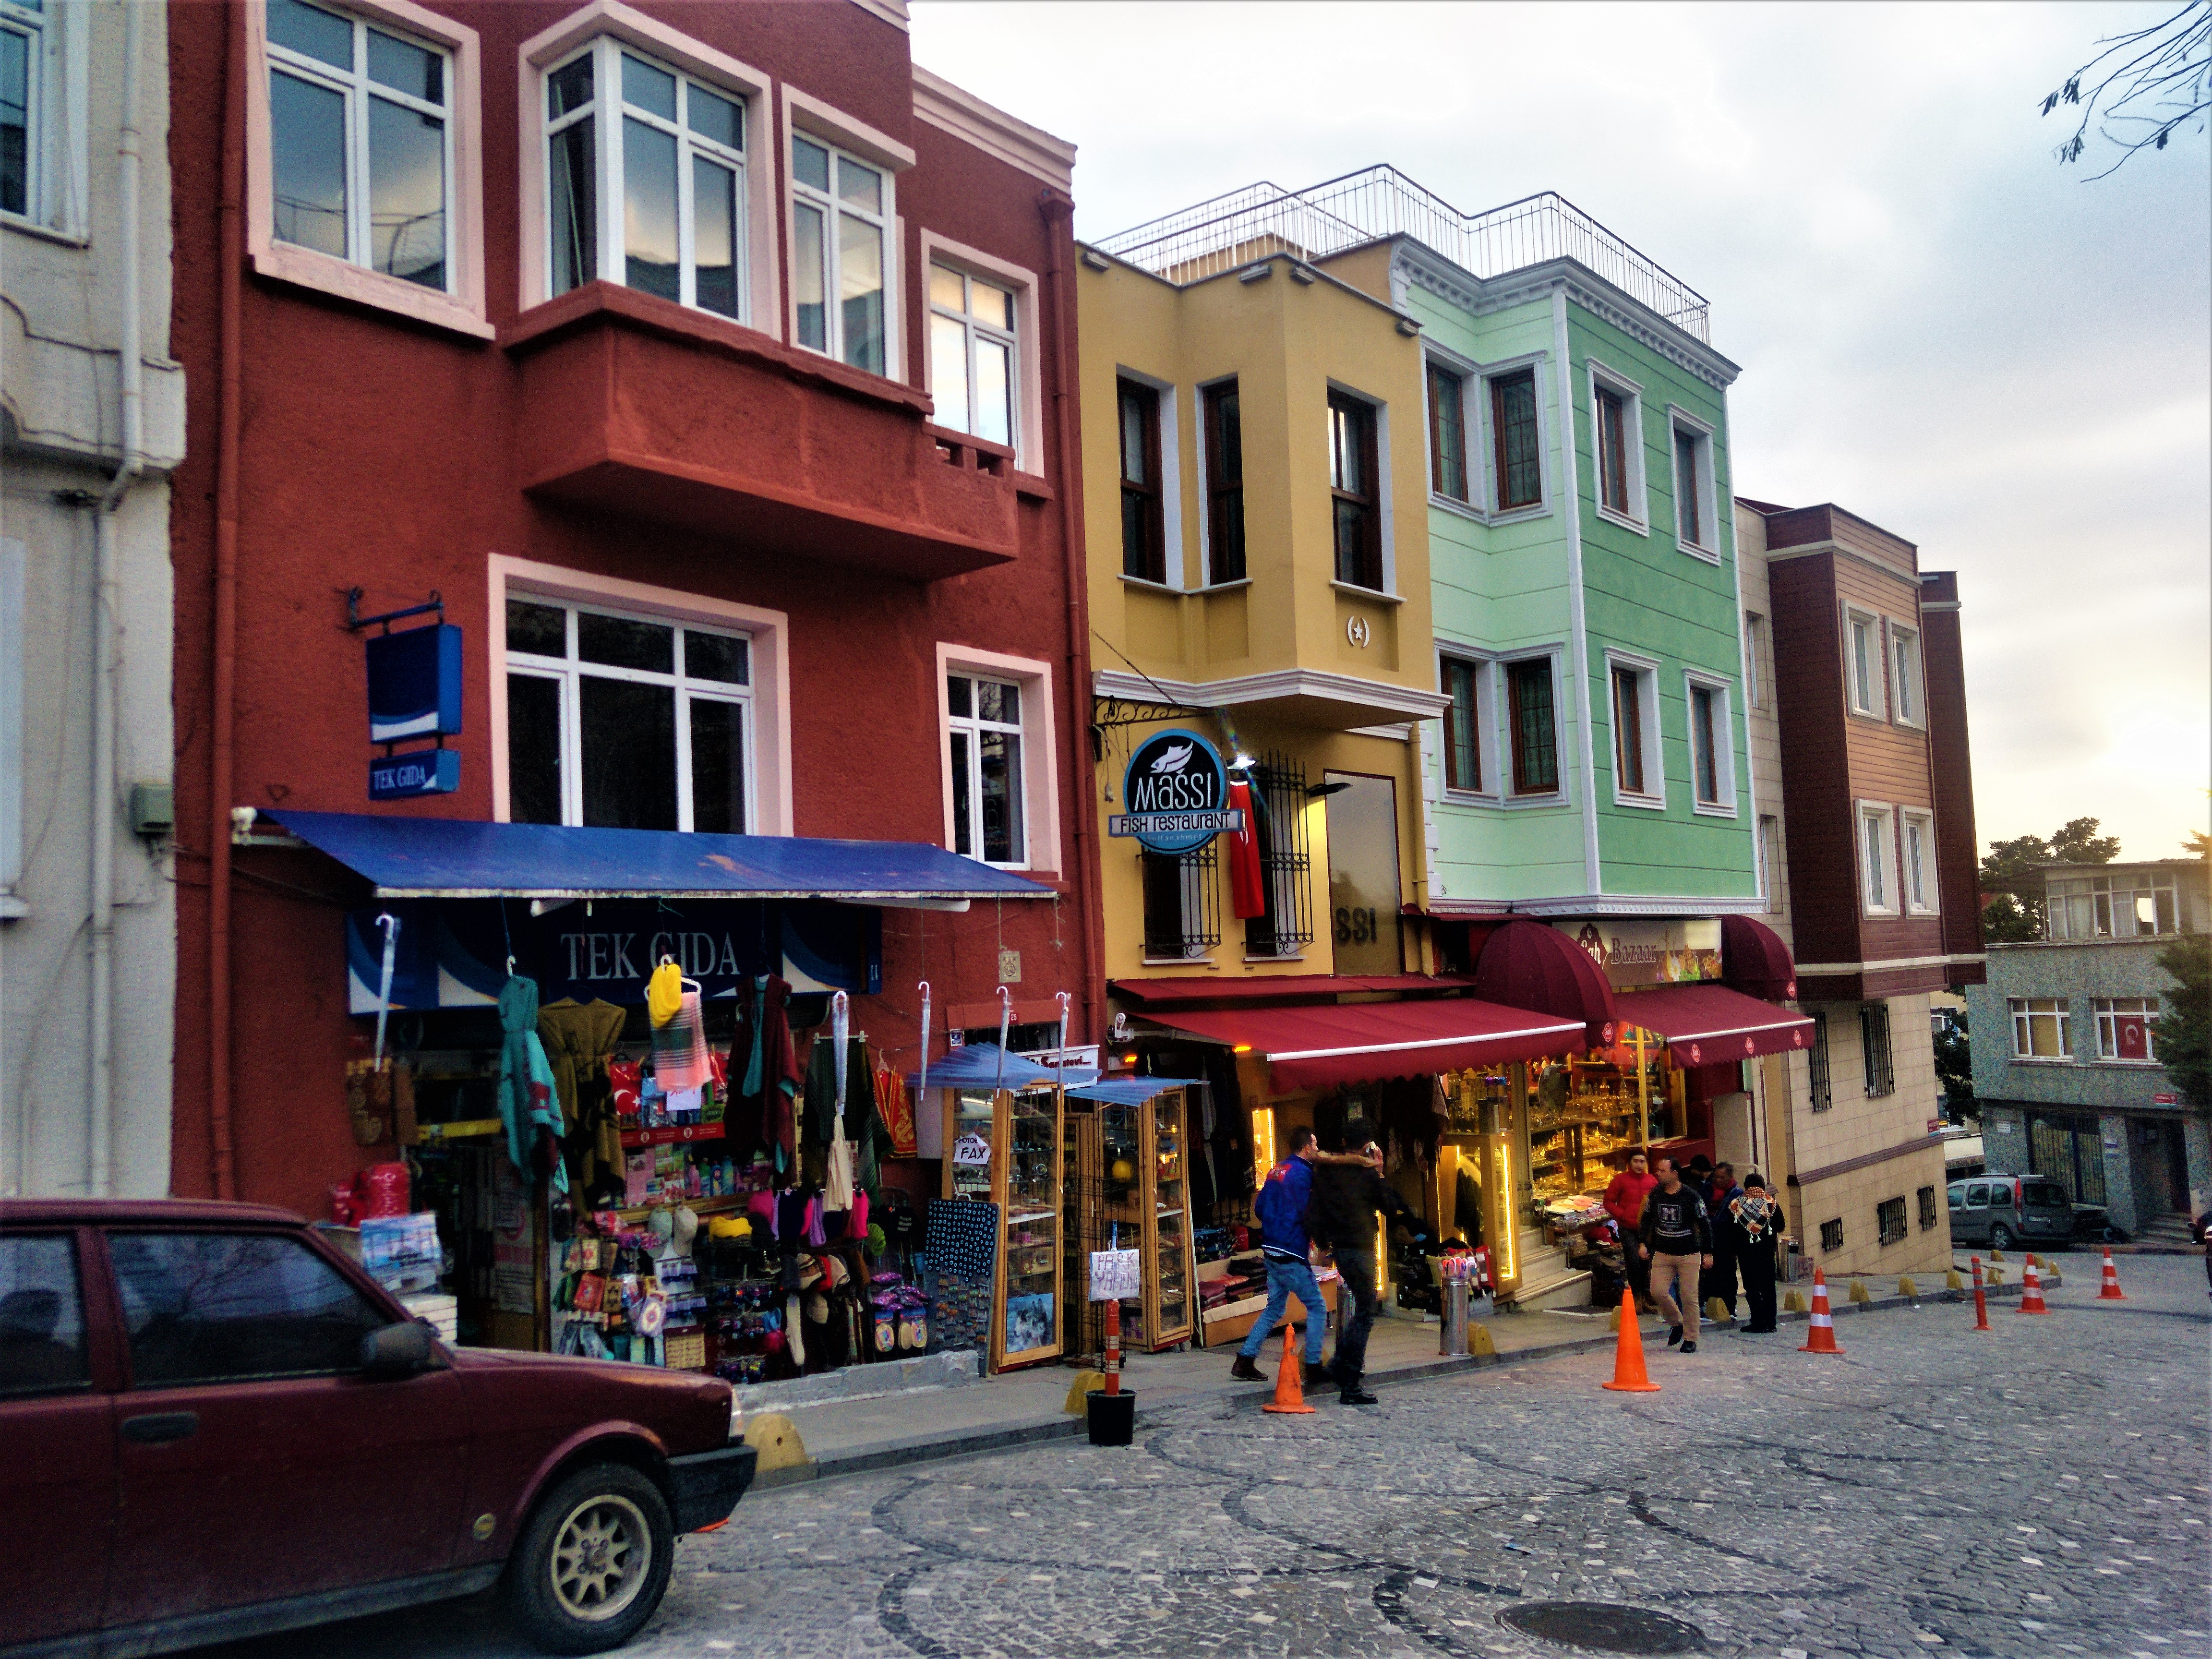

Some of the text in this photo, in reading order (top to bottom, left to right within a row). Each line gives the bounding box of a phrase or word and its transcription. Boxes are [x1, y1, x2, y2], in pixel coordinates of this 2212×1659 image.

[373, 765, 426, 790] TEK GIDA
[1121, 817, 1148, 833] FISH
[560, 931, 741, 980] TEK GIDA
[1611, 938, 1657, 964] Bazaar
[961, 1147, 986, 1159] FAX
[1098, 1252, 1135, 1270] PARK
